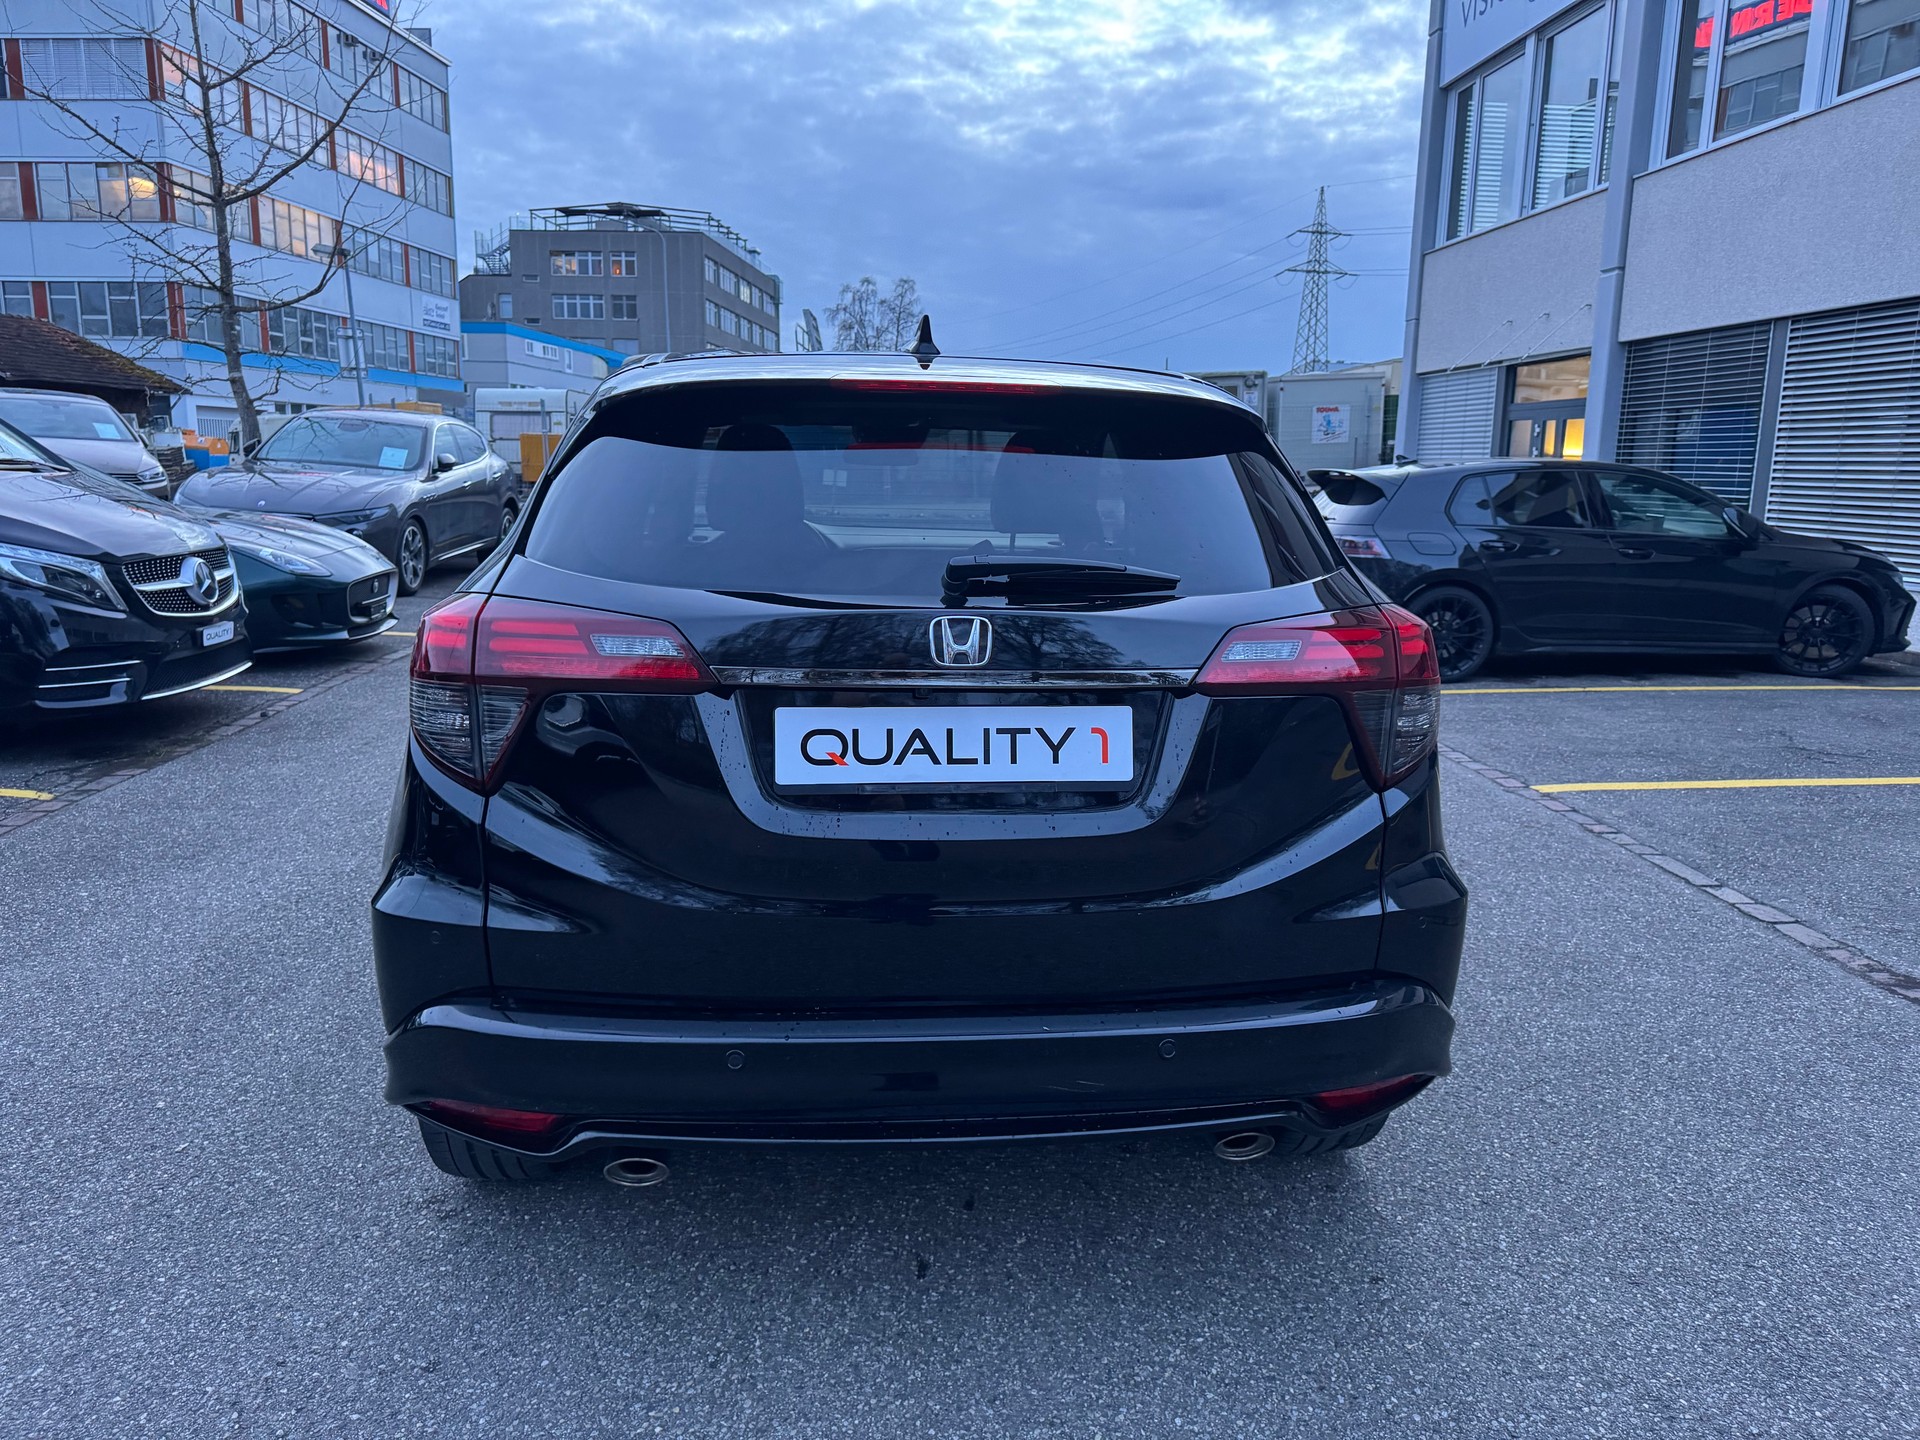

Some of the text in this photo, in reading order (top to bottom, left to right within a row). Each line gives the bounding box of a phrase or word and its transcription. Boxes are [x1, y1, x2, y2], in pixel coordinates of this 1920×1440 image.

[206, 628, 230, 641] QUALITY
[800, 727, 1109, 766] QUALITY 1
